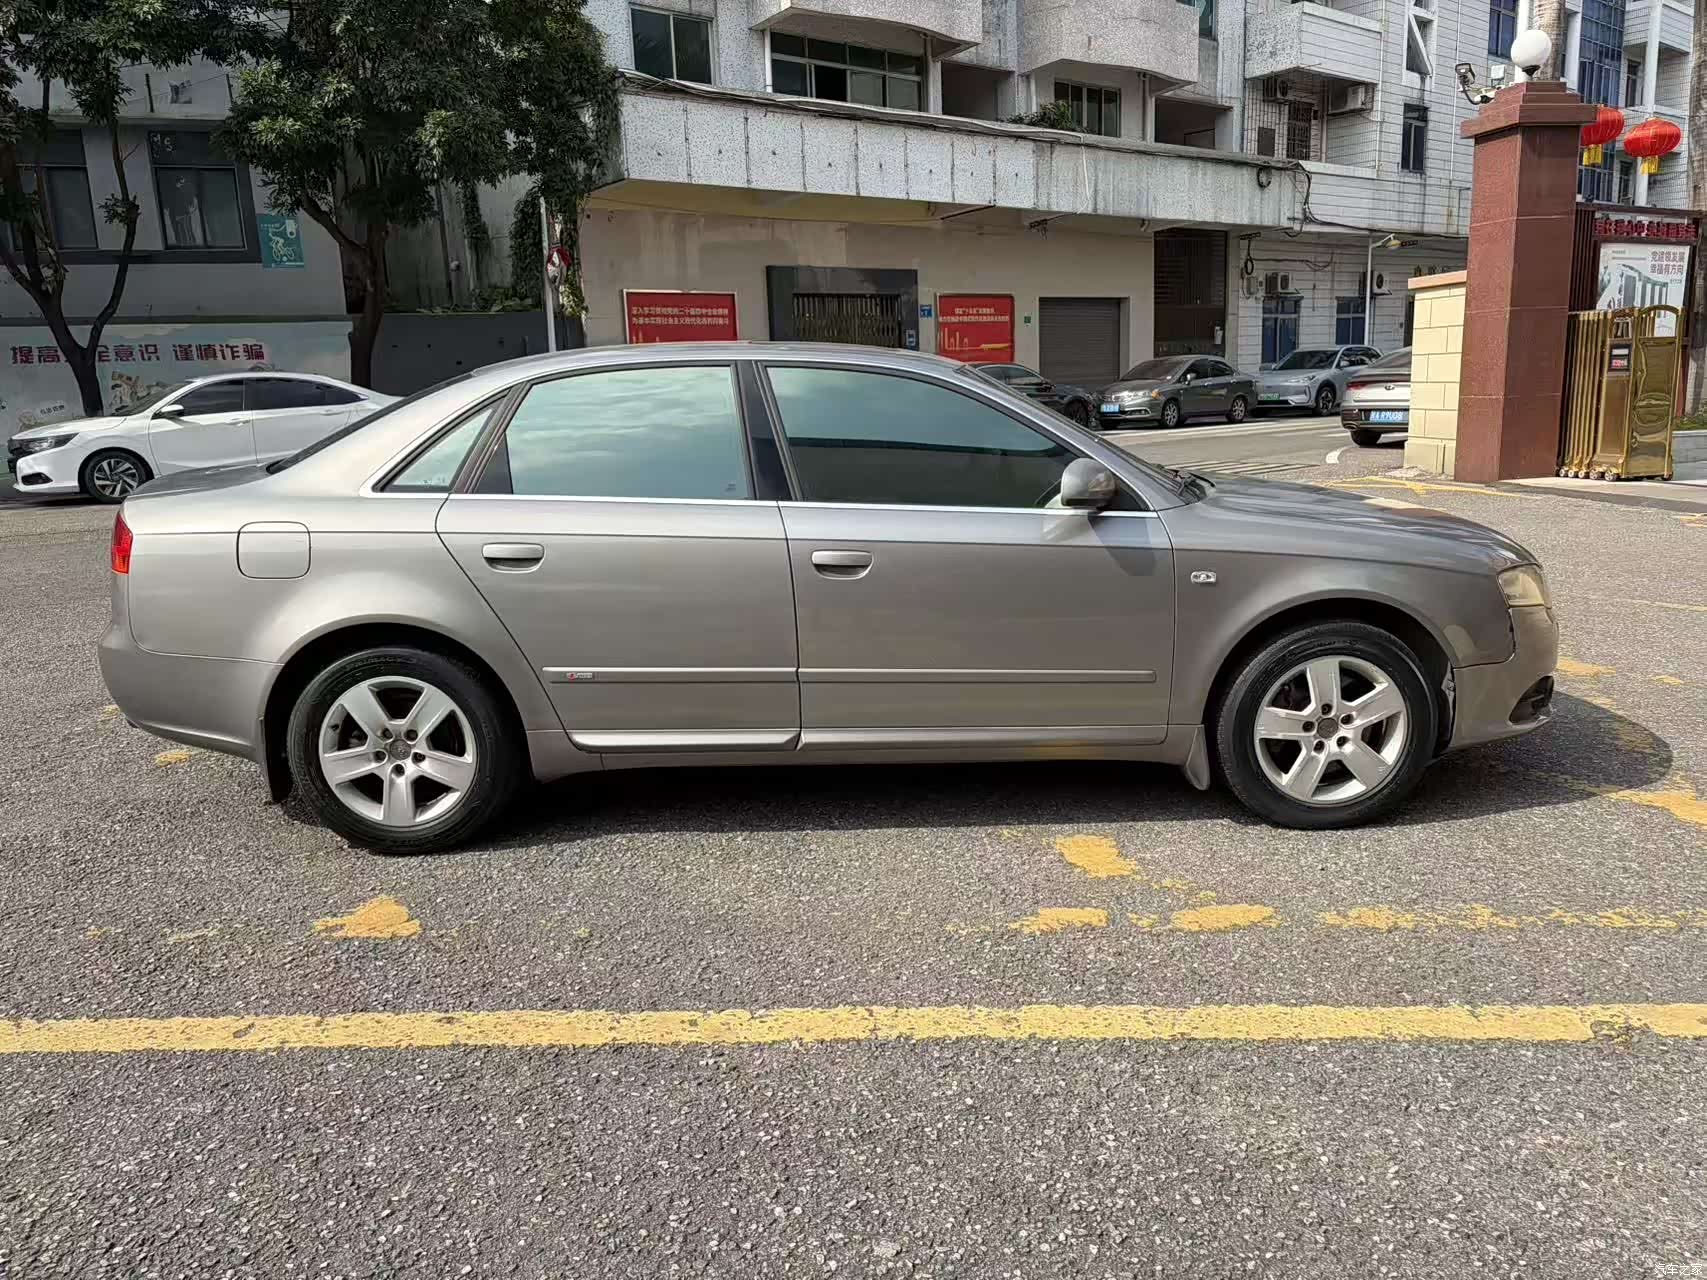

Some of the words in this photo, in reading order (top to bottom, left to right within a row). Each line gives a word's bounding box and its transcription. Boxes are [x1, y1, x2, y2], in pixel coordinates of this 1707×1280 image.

[11, 344, 160, 364] 提高全意识
[172, 343, 265, 361] 谨慎诈骗
